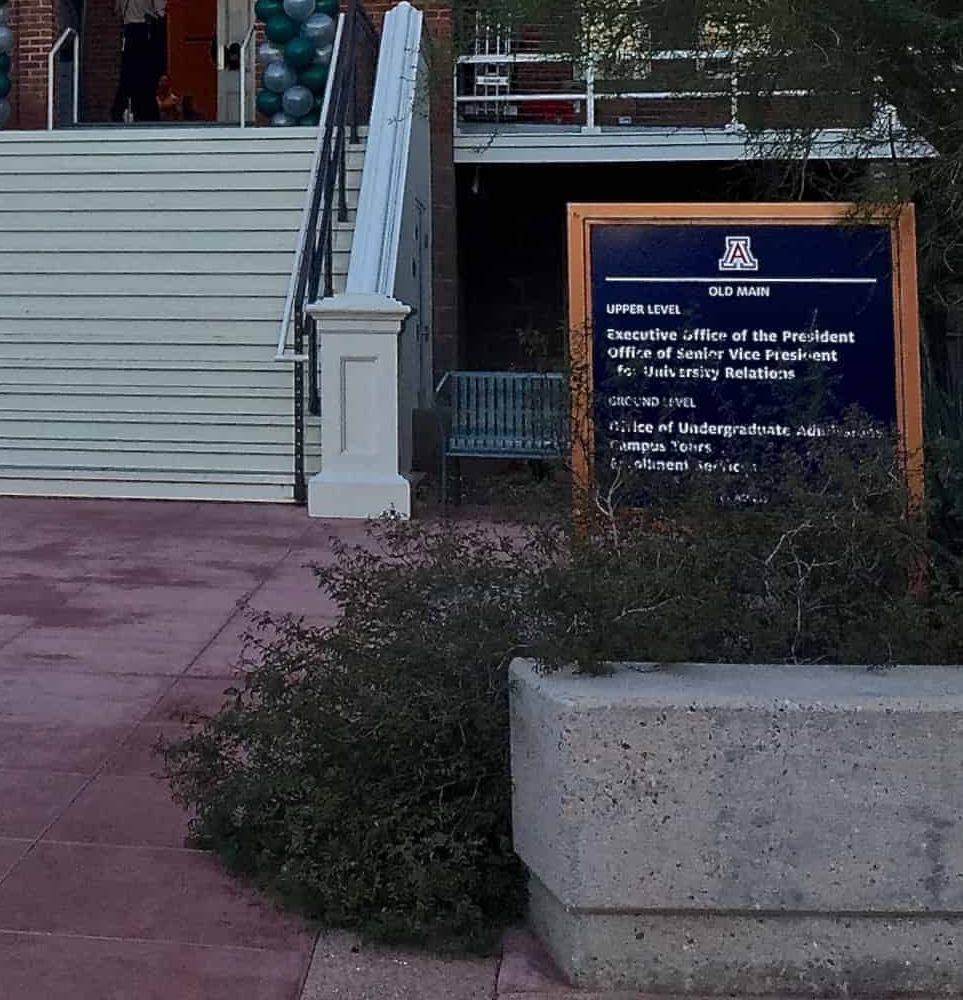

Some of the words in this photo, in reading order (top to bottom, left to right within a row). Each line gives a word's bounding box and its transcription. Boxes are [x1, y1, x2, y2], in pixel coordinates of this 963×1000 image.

[719, 236, 758, 271] A
[708, 286, 733, 297] OLD
[736, 286, 770, 297] MAIN
[606, 304, 644, 315] UPPER
[647, 304, 681, 315] LEVEL
[606, 327, 677, 341] Executive
[731, 329, 748, 342] of
[752, 329, 777, 342] the
[782, 329, 855, 343] President
[656, 346, 673, 360] of
[728, 347, 761, 360] Vice
[725, 366, 796, 380] Relations
[662, 396, 696, 408] EVEL
[678, 421, 791, 438] Undergraduate
